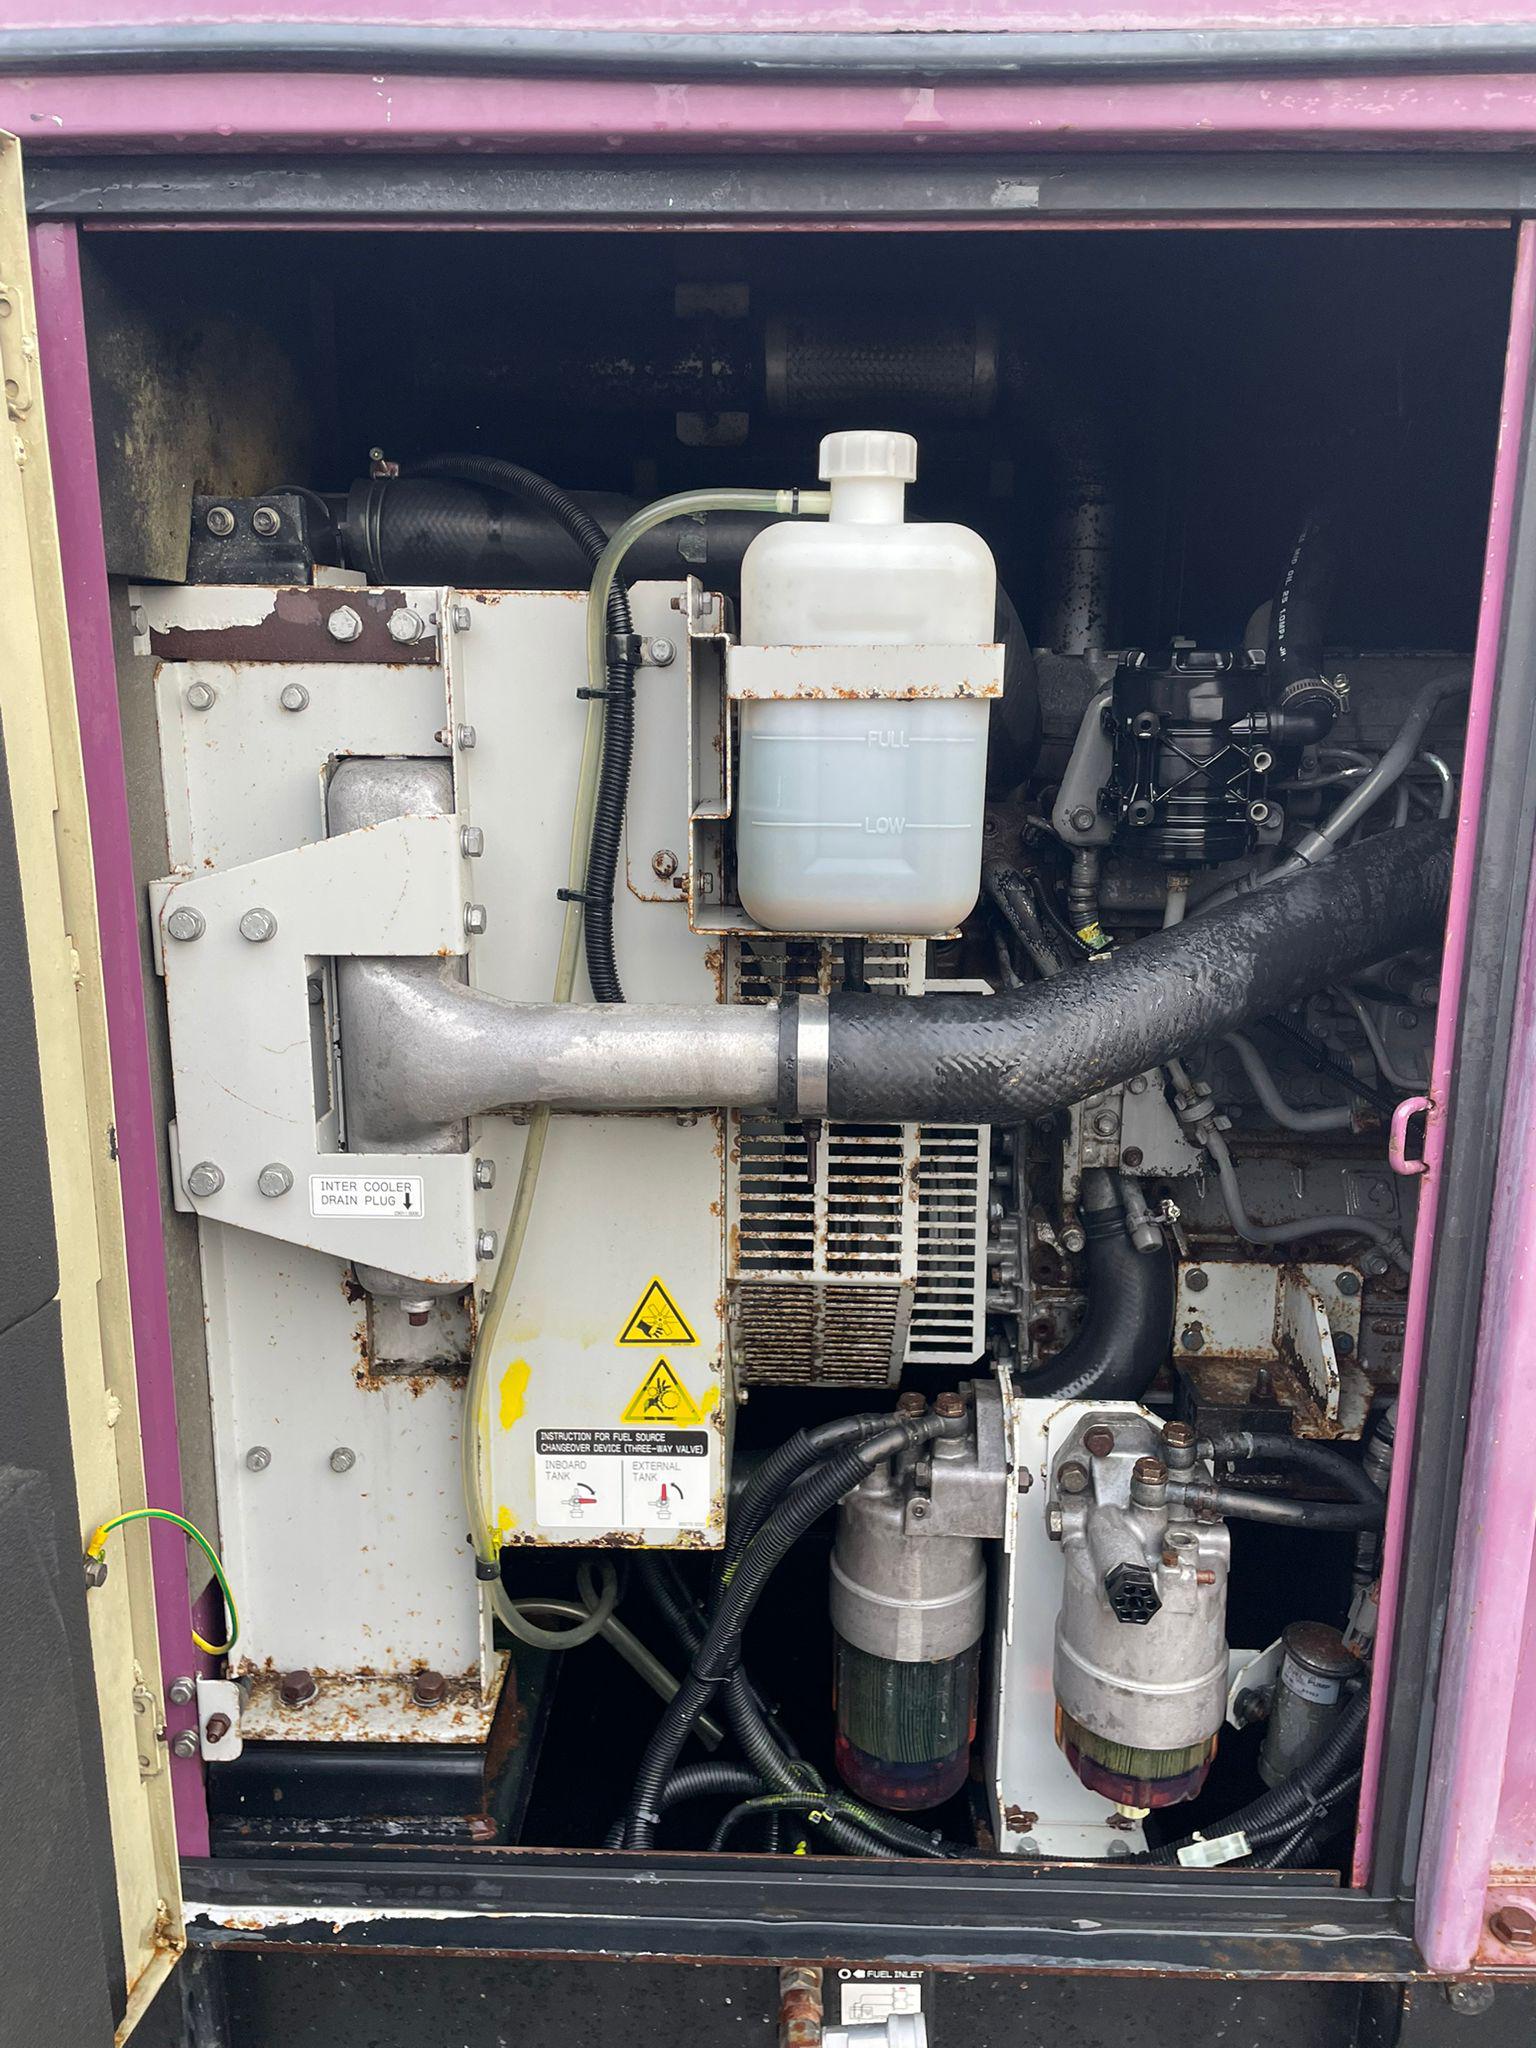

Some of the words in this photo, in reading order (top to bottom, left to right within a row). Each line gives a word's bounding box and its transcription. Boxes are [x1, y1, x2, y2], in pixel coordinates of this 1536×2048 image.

[1285, 570, 1295, 586] OIL
[867, 730, 910, 748] FULL
[865, 816, 906, 835] LOW
[320, 1181, 358, 1192] INTER
[364, 1181, 412, 1193] COOLER
[321, 1195, 358, 1205] DRAIN
[365, 1195, 396, 1206] PLUG
[541, 1432, 592, 1441] INSTRUCTION
[594, 1432, 611, 1441] FOR
[613, 1432, 633, 1442] FUEL
[635, 1433, 666, 1442] SOURCE
[541, 1443, 591, 1453] CHANGEOVER
[593, 1444, 621, 1453] DEVICE
[624, 1444, 673, 1454] (THREE-WAY
[676, 1445, 704, 1454] VALVE)
[545, 1460, 587, 1470] INBOARD
[632, 1461, 681, 1471] EXTERNAL
[545, 1472, 571, 1481] TANK
[632, 1473, 658, 1482] TANK
[866, 1970, 893, 1979] FUEL
[894, 1970, 924, 1978] INLET
